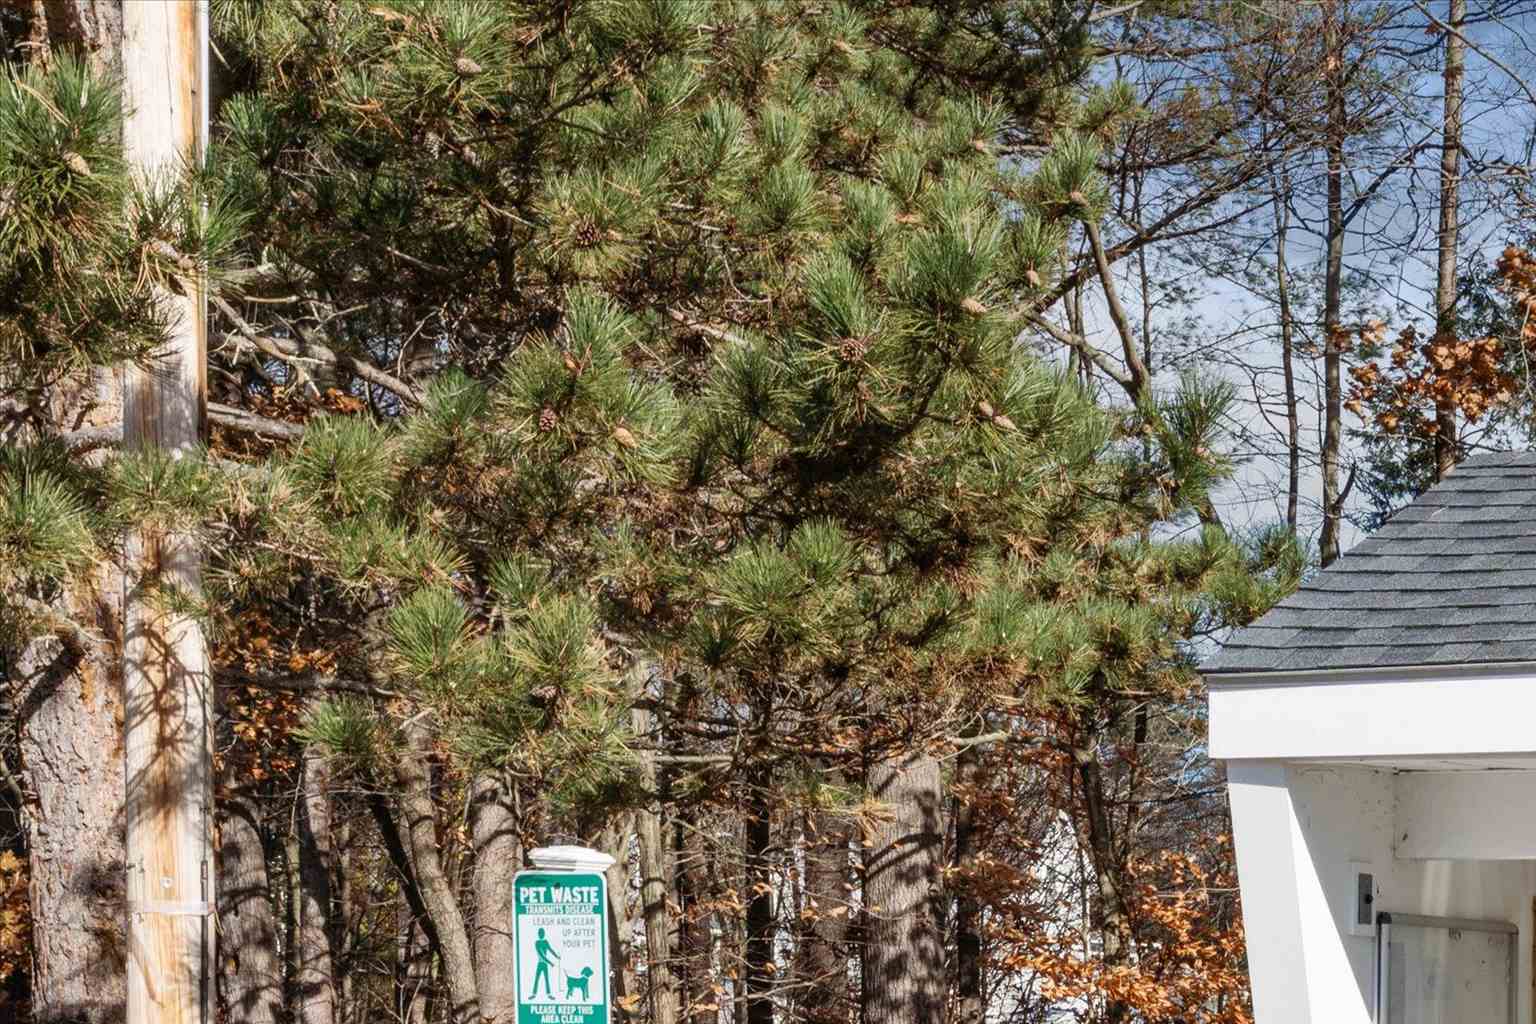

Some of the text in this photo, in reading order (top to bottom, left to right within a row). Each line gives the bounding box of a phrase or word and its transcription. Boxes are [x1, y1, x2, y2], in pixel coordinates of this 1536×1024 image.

[520, 886, 599, 905] PET WASTE
[532, 917, 595, 926] LEASH AND CLEAN
[562, 928, 596, 937] UP AFTER
[562, 940, 596, 948] YOUR PET
[530, 1005, 594, 1015] PLEASE KEEP THIS
[541, 1015, 560, 1024] AREA
